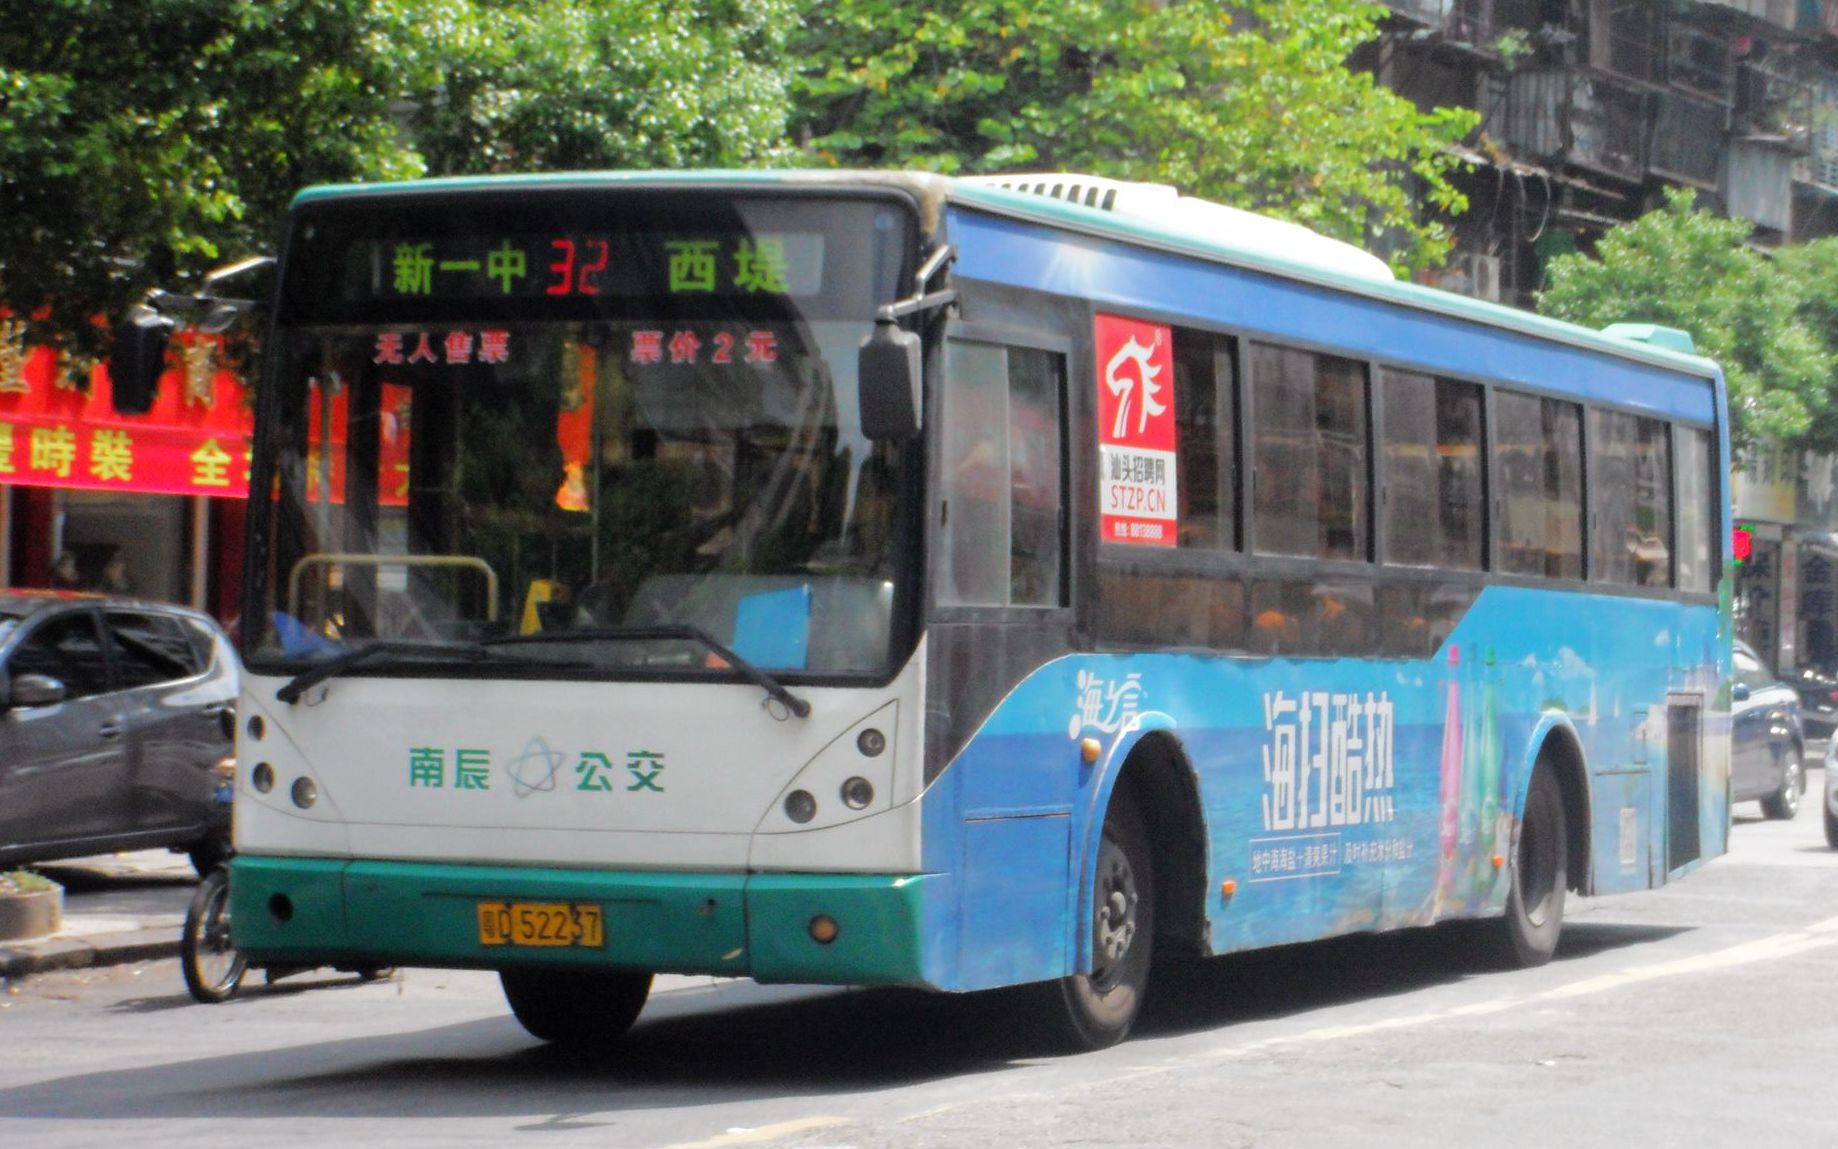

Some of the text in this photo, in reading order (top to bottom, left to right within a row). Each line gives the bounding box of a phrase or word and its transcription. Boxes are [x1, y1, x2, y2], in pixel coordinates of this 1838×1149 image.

[394, 238, 789, 295] 新一中 32 西堤
[373, 329, 778, 364] 无人售票 票价2元
[190, 438, 253, 487] 全
[1110, 453, 1166, 487] 汕头招聘网
[1111, 484, 1166, 513] STZP.CN
[410, 746, 664, 792] 南辰 公交
